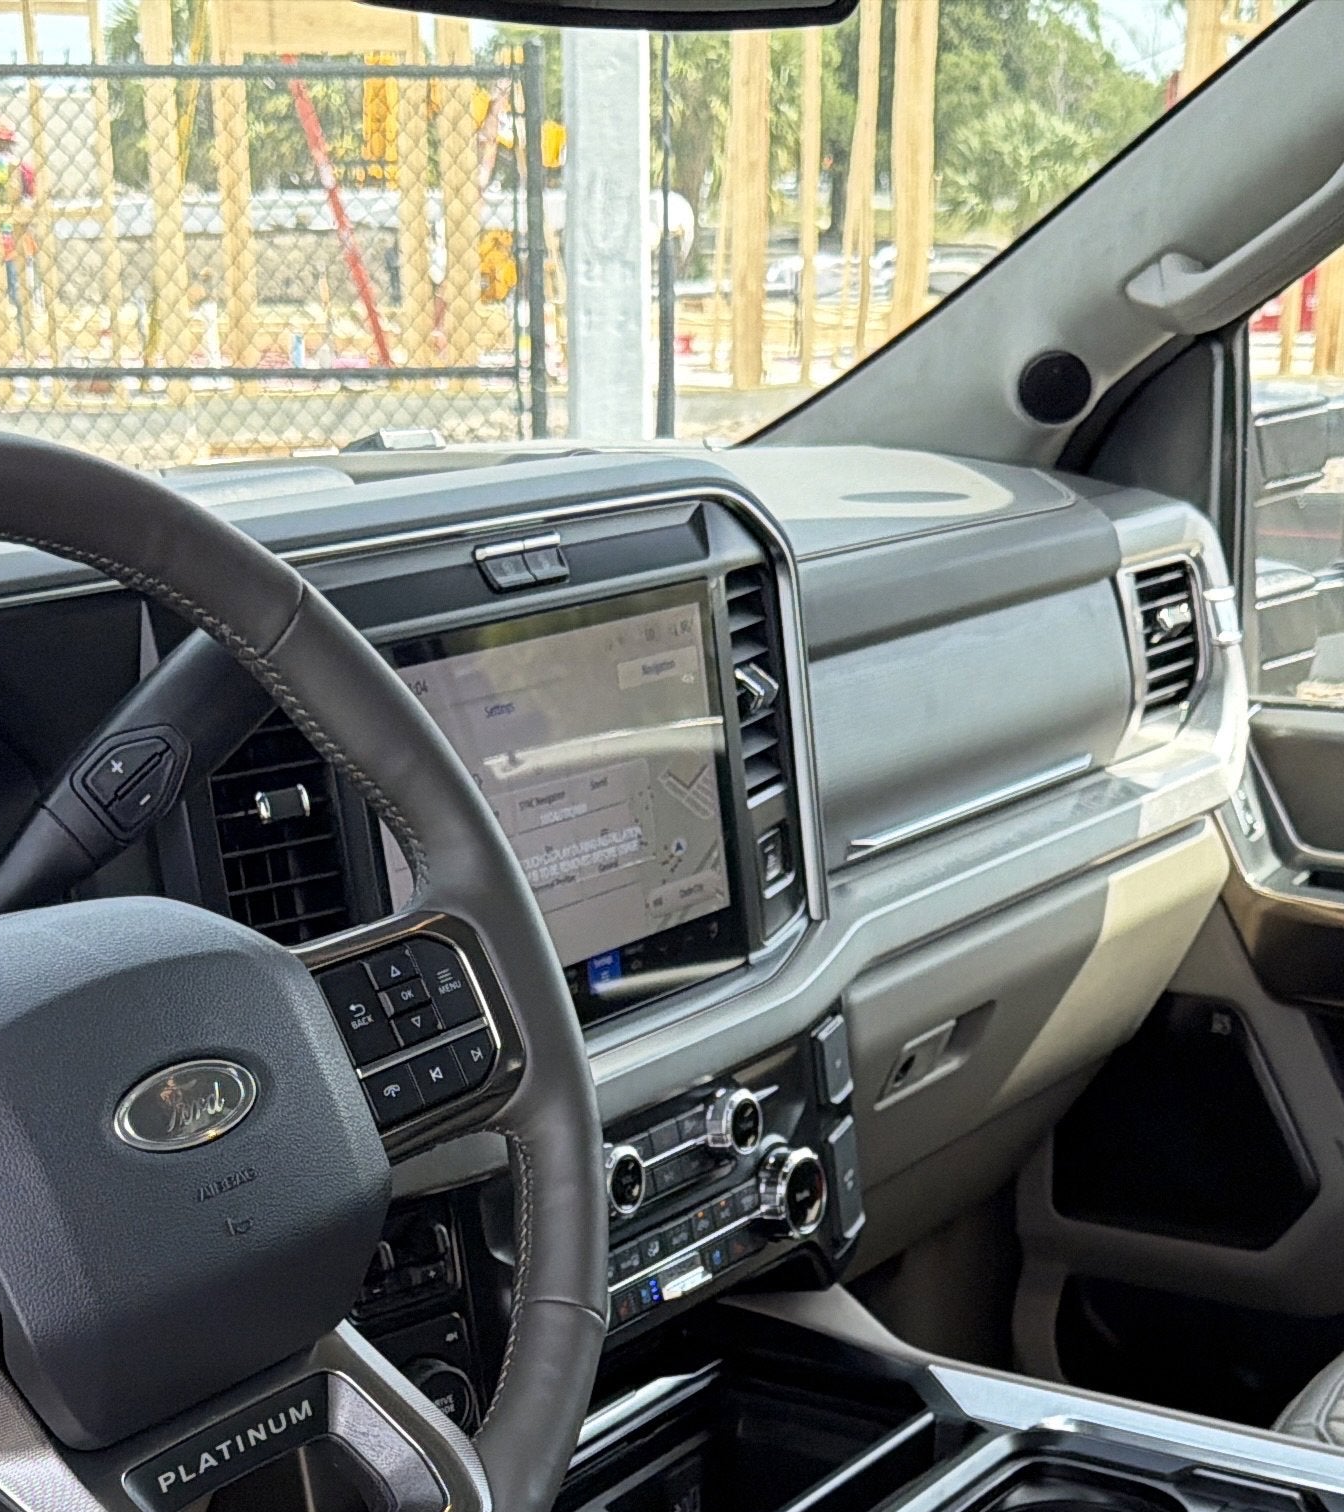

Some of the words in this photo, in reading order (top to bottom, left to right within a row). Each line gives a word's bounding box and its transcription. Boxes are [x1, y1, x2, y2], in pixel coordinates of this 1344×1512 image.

[400, 989, 414, 1001] OK
[438, 980, 462, 995] MENU
[351, 1014, 375, 1030] BACK
[160, 1079, 225, 1133] Ford
[198, 1166, 258, 1201] AIRBAG
[157, 1399, 313, 1493] PLATINUM
